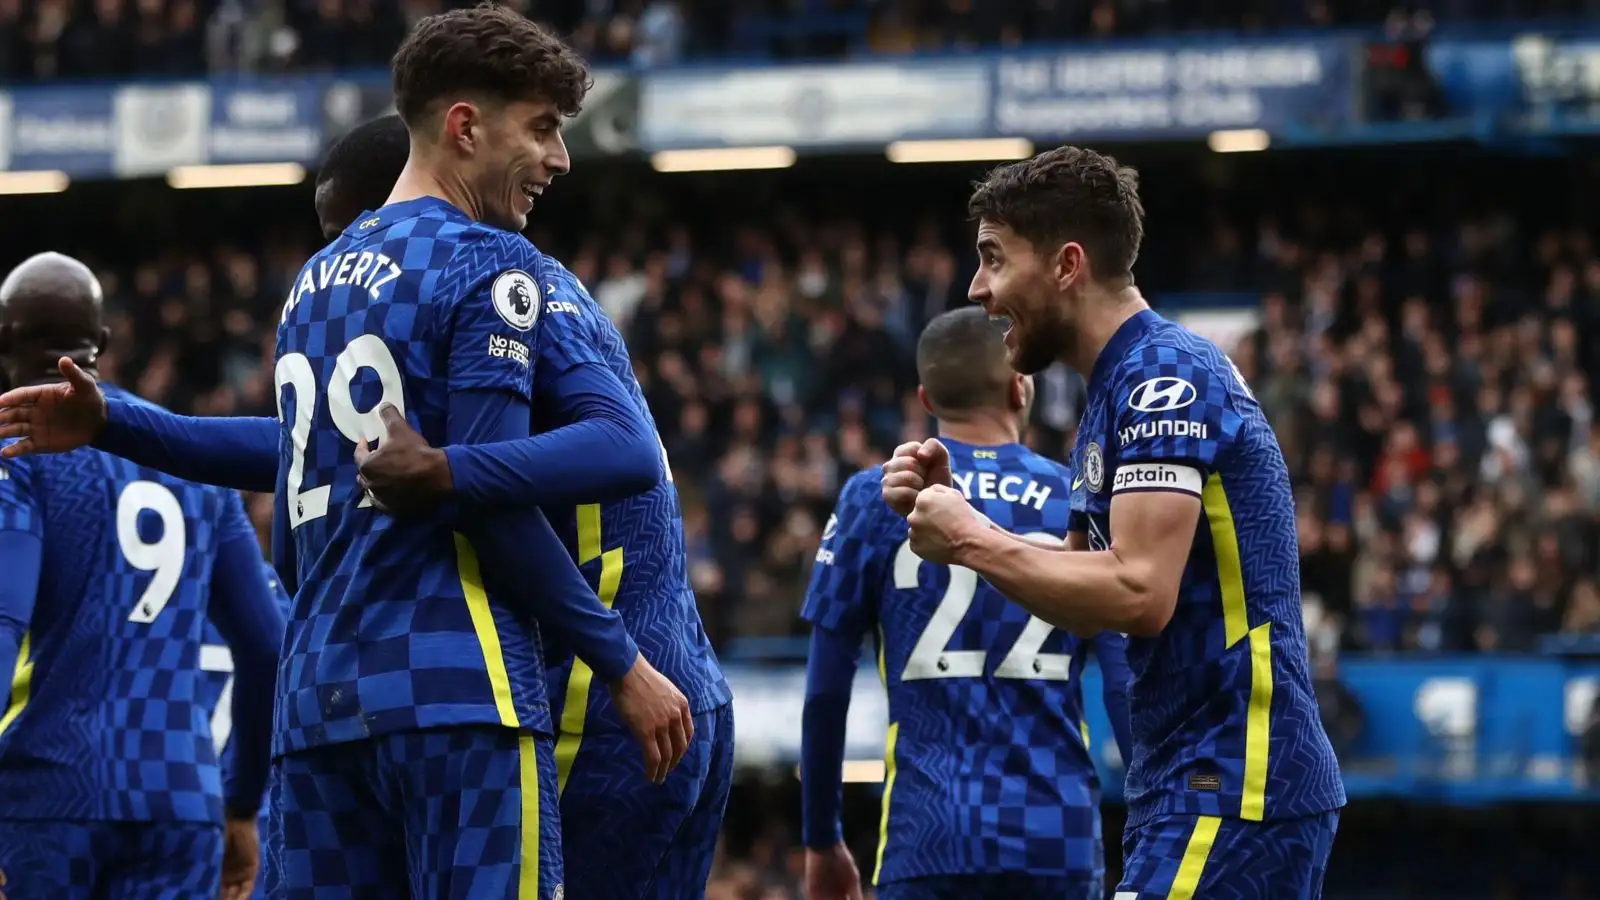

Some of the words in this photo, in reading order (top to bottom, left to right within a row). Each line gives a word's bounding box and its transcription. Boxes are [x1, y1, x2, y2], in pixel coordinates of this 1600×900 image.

[359, 217, 380, 230] CFC
[281, 251, 402, 325] HAVERTZ
[488, 345, 507, 358] for
[489, 334, 508, 348] No
[509, 339, 529, 358] room
[275, 333, 406, 530] 29
[1118, 420, 1208, 446] HYUNDAI
[972, 450, 998, 460] CFC
[1114, 466, 1178, 487] aptain
[952, 471, 1053, 511] YECH
[116, 480, 186, 624] 9
[893, 532, 1073, 682] 22
